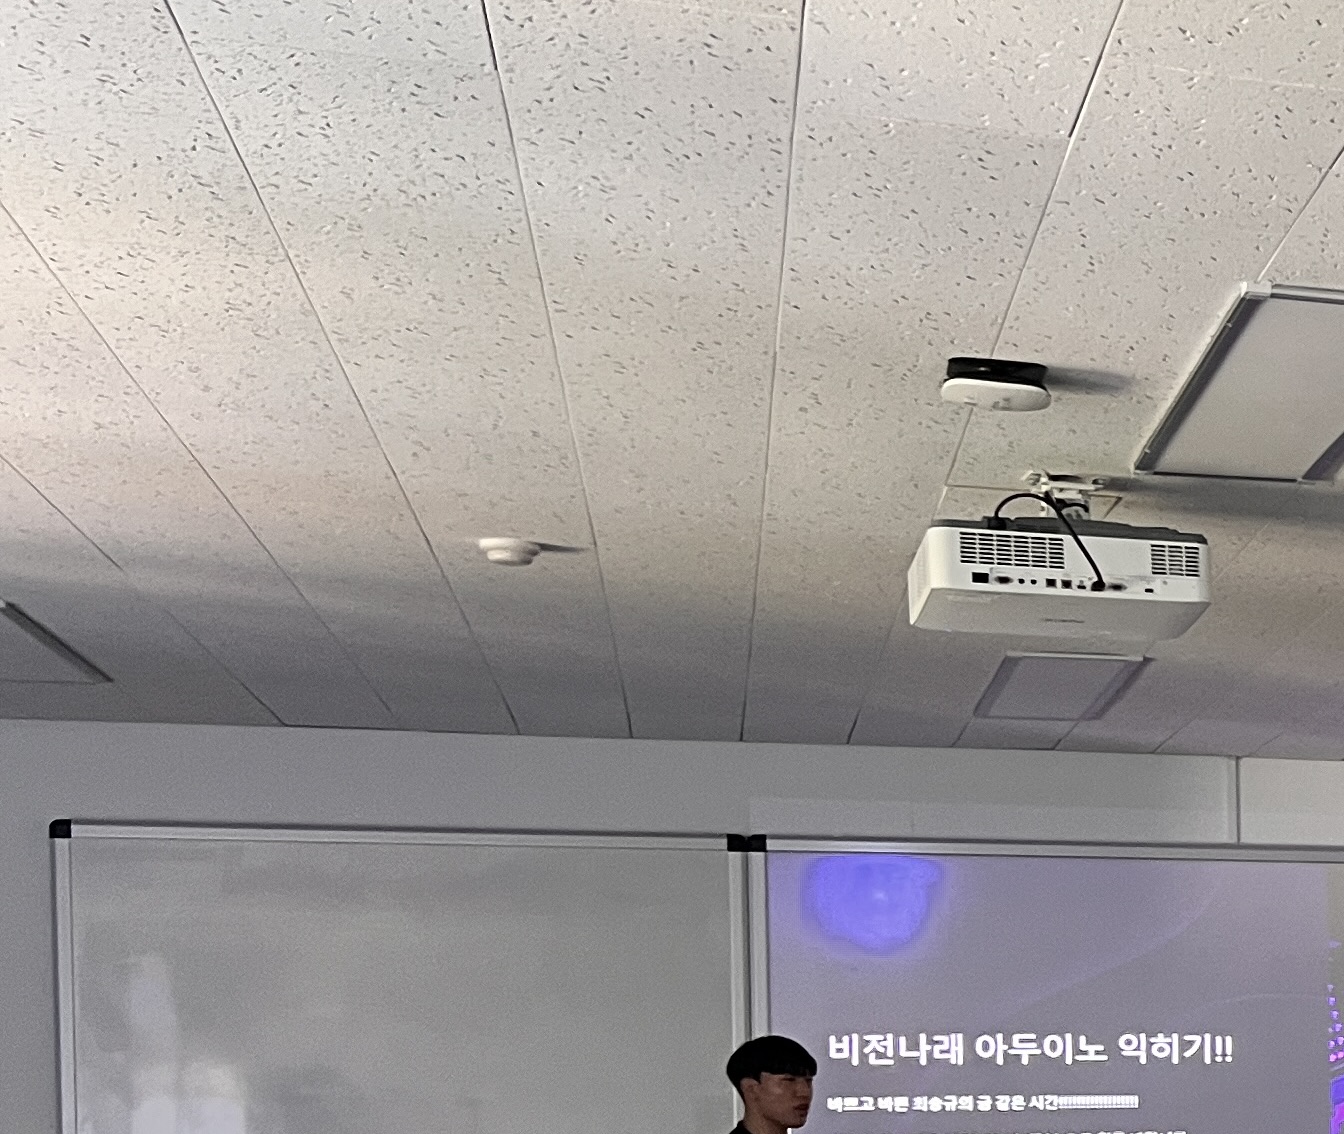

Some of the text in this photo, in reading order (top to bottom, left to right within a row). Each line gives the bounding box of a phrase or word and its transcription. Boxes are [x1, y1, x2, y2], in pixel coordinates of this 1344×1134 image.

[828, 1032, 1233, 1066] 비전나래 아두이노 익히기!!
[994, 1094, 1027, 1112] 같은
